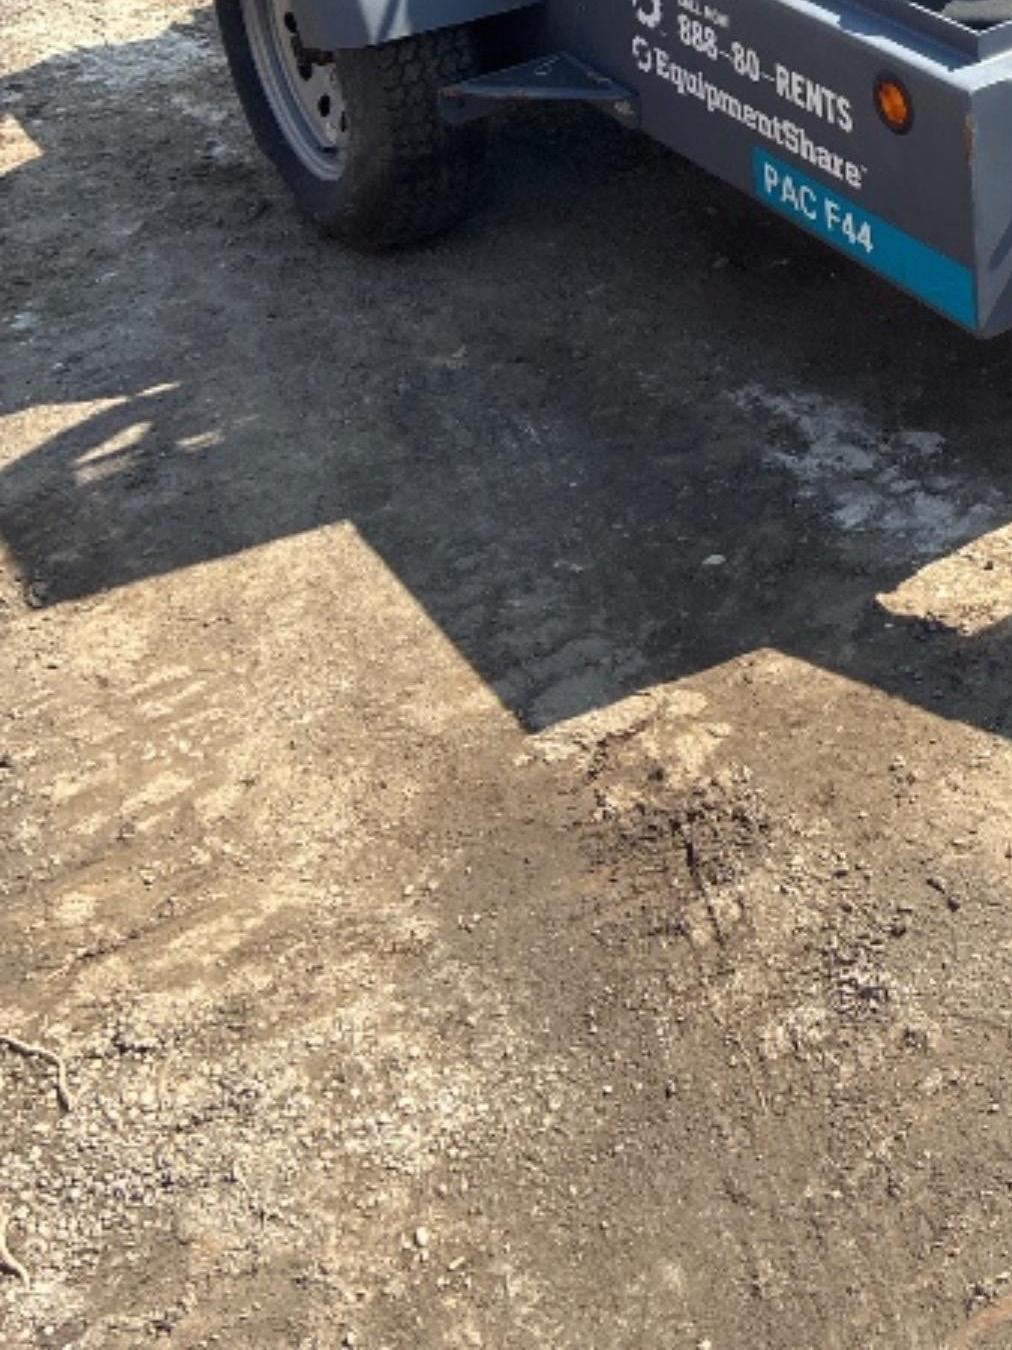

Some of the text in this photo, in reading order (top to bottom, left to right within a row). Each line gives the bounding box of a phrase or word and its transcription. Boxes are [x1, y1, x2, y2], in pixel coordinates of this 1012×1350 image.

[654, 48, 863, 189] EquipmentShare
[677, 14, 853, 134] 888-80-RENTS
[763, 162, 874, 254] PAC F44
